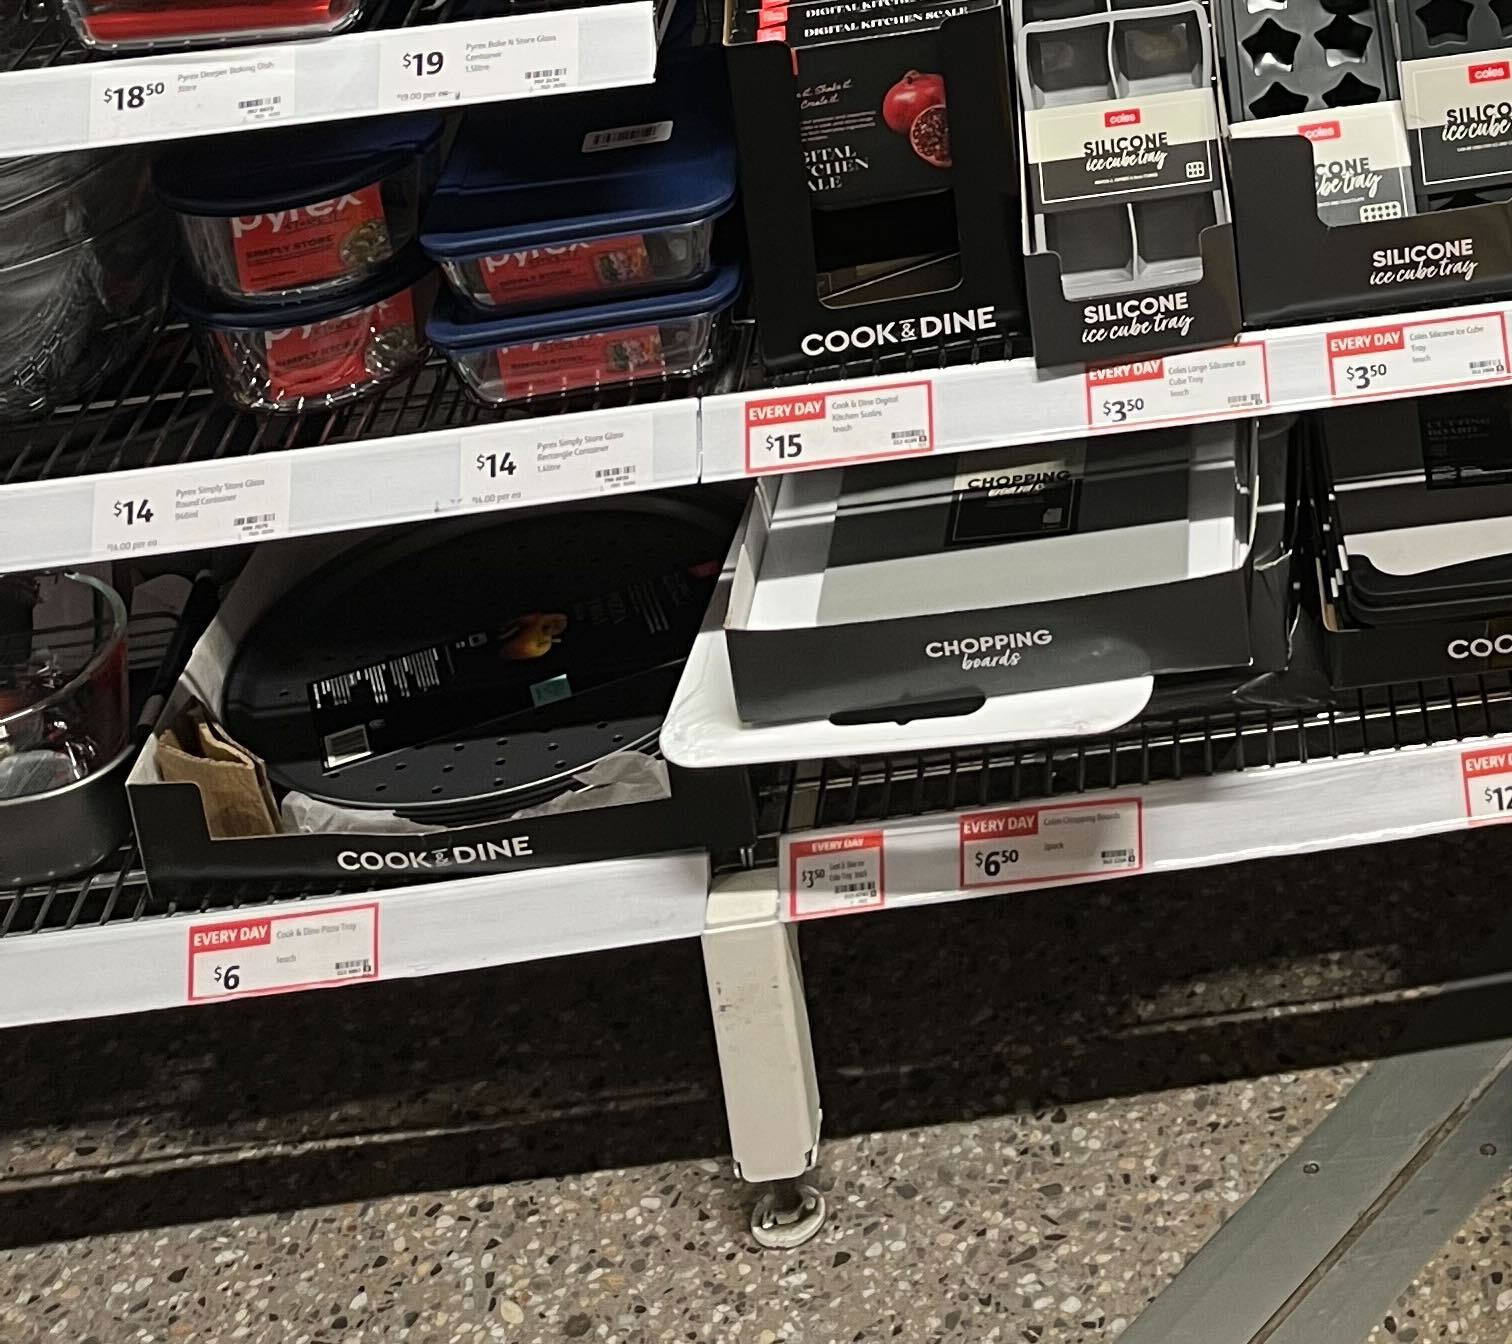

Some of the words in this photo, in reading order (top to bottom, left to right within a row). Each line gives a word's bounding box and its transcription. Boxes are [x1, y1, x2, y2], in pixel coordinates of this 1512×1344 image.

[403, 51, 444, 76] $19
[1108, 112, 1136, 124] coles
[1083, 132, 1168, 157] SILICONE
[1372, 238, 1475, 268] SILICONE
[1369, 265, 1393, 285] ice
[1397, 261, 1437, 280] cube
[1439, 256, 1478, 280] tray
[1083, 291, 1188, 325] SILICONE
[1082, 324, 1106, 344] ice
[1108, 317, 1148, 340] cube
[1150, 312, 1195, 336] tray
[749, 401, 789, 421] EVERY
[791, 398, 822, 417] DAY
[765, 433, 803, 460] $15
[476, 451, 517, 479] $14
[113, 496, 153, 526] $14
[925, 629, 1053, 659] CHOPPING
[961, 649, 1021, 672] boards
[1465, 754, 1504, 772] EVERY
[963, 818, 1001, 836] EVERY
[1003, 815, 1036, 832] DAY
[192, 929, 234, 948] EVERY
[236, 925, 268, 943] DAY
[213, 963, 240, 990] $6
